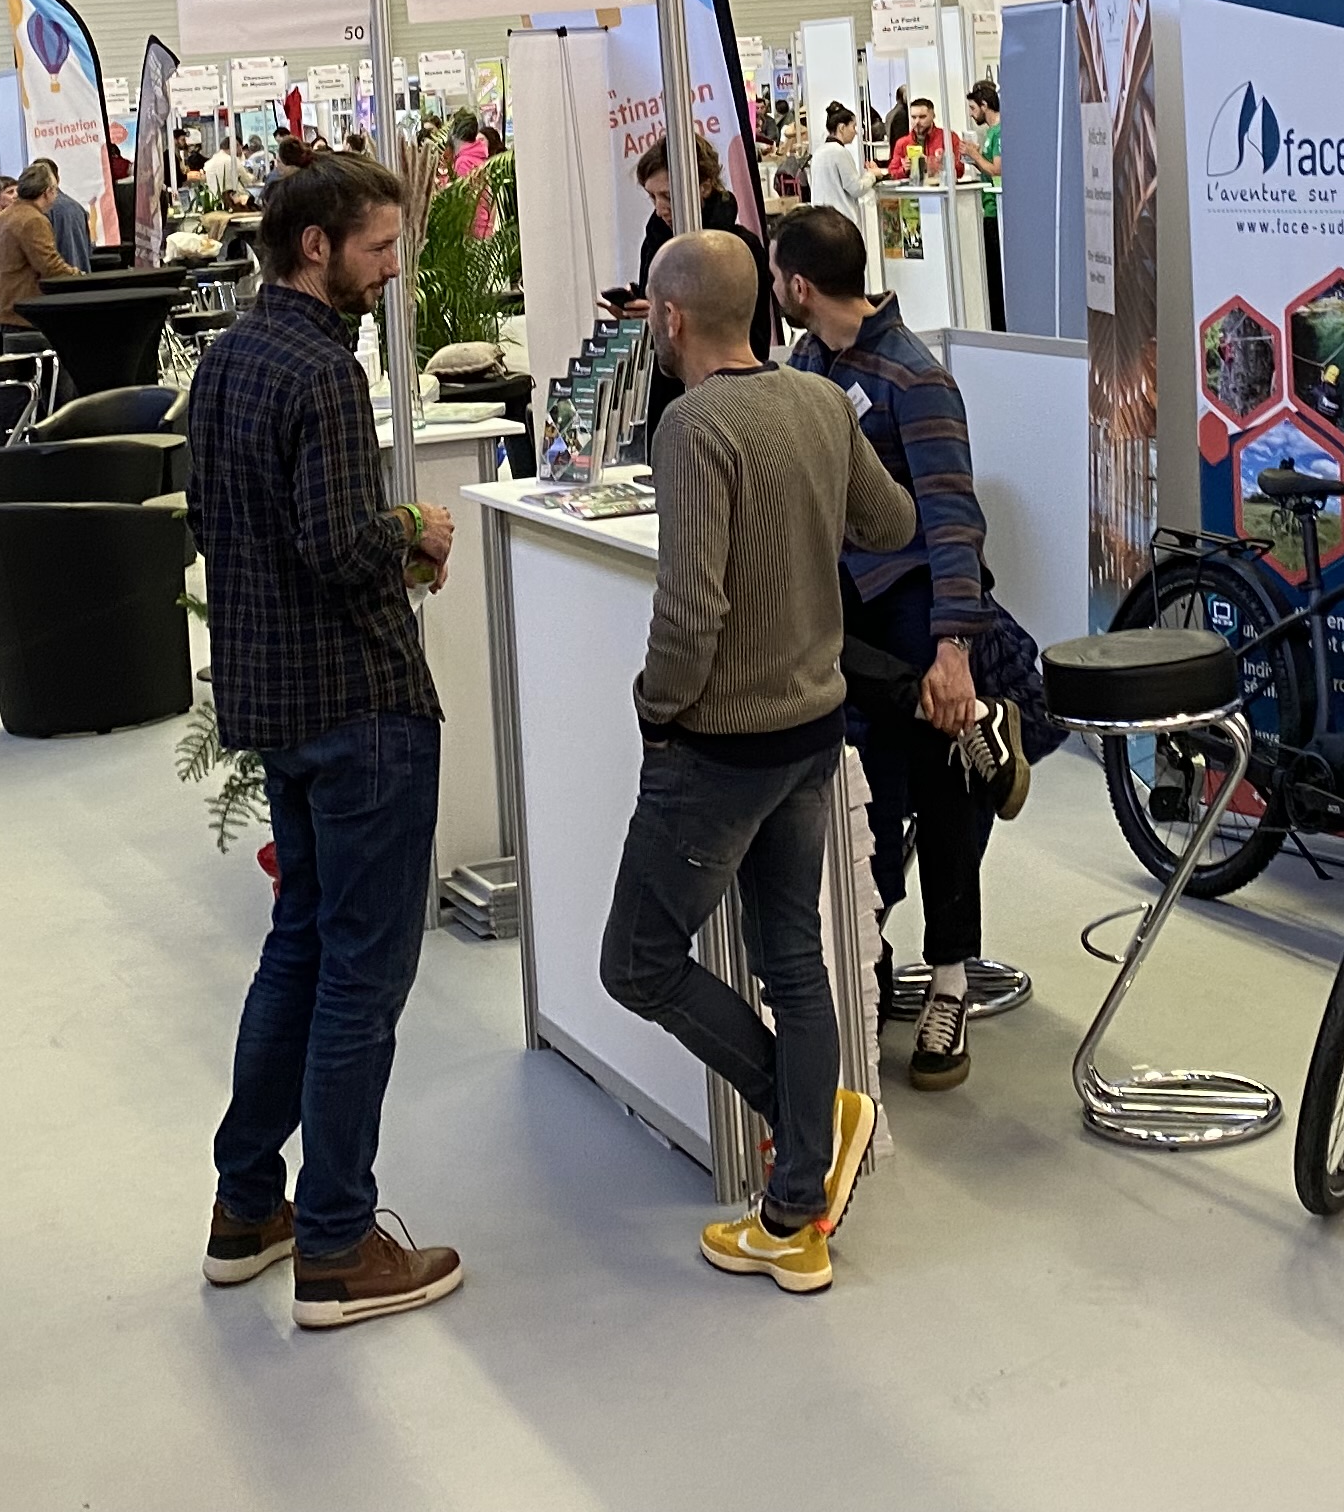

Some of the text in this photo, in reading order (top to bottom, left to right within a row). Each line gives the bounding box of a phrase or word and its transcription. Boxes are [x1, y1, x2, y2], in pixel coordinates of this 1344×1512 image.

[344, 26, 365, 40] 50
[34, 118, 97, 138] Destination
[55, 133, 99, 150] Ardèche
[624, 116, 720, 159] Ardèe
[1207, 181, 1297, 202] l'aventure
[1308, 188, 1338, 203] sur
[1327, 615, 1344, 631] en
